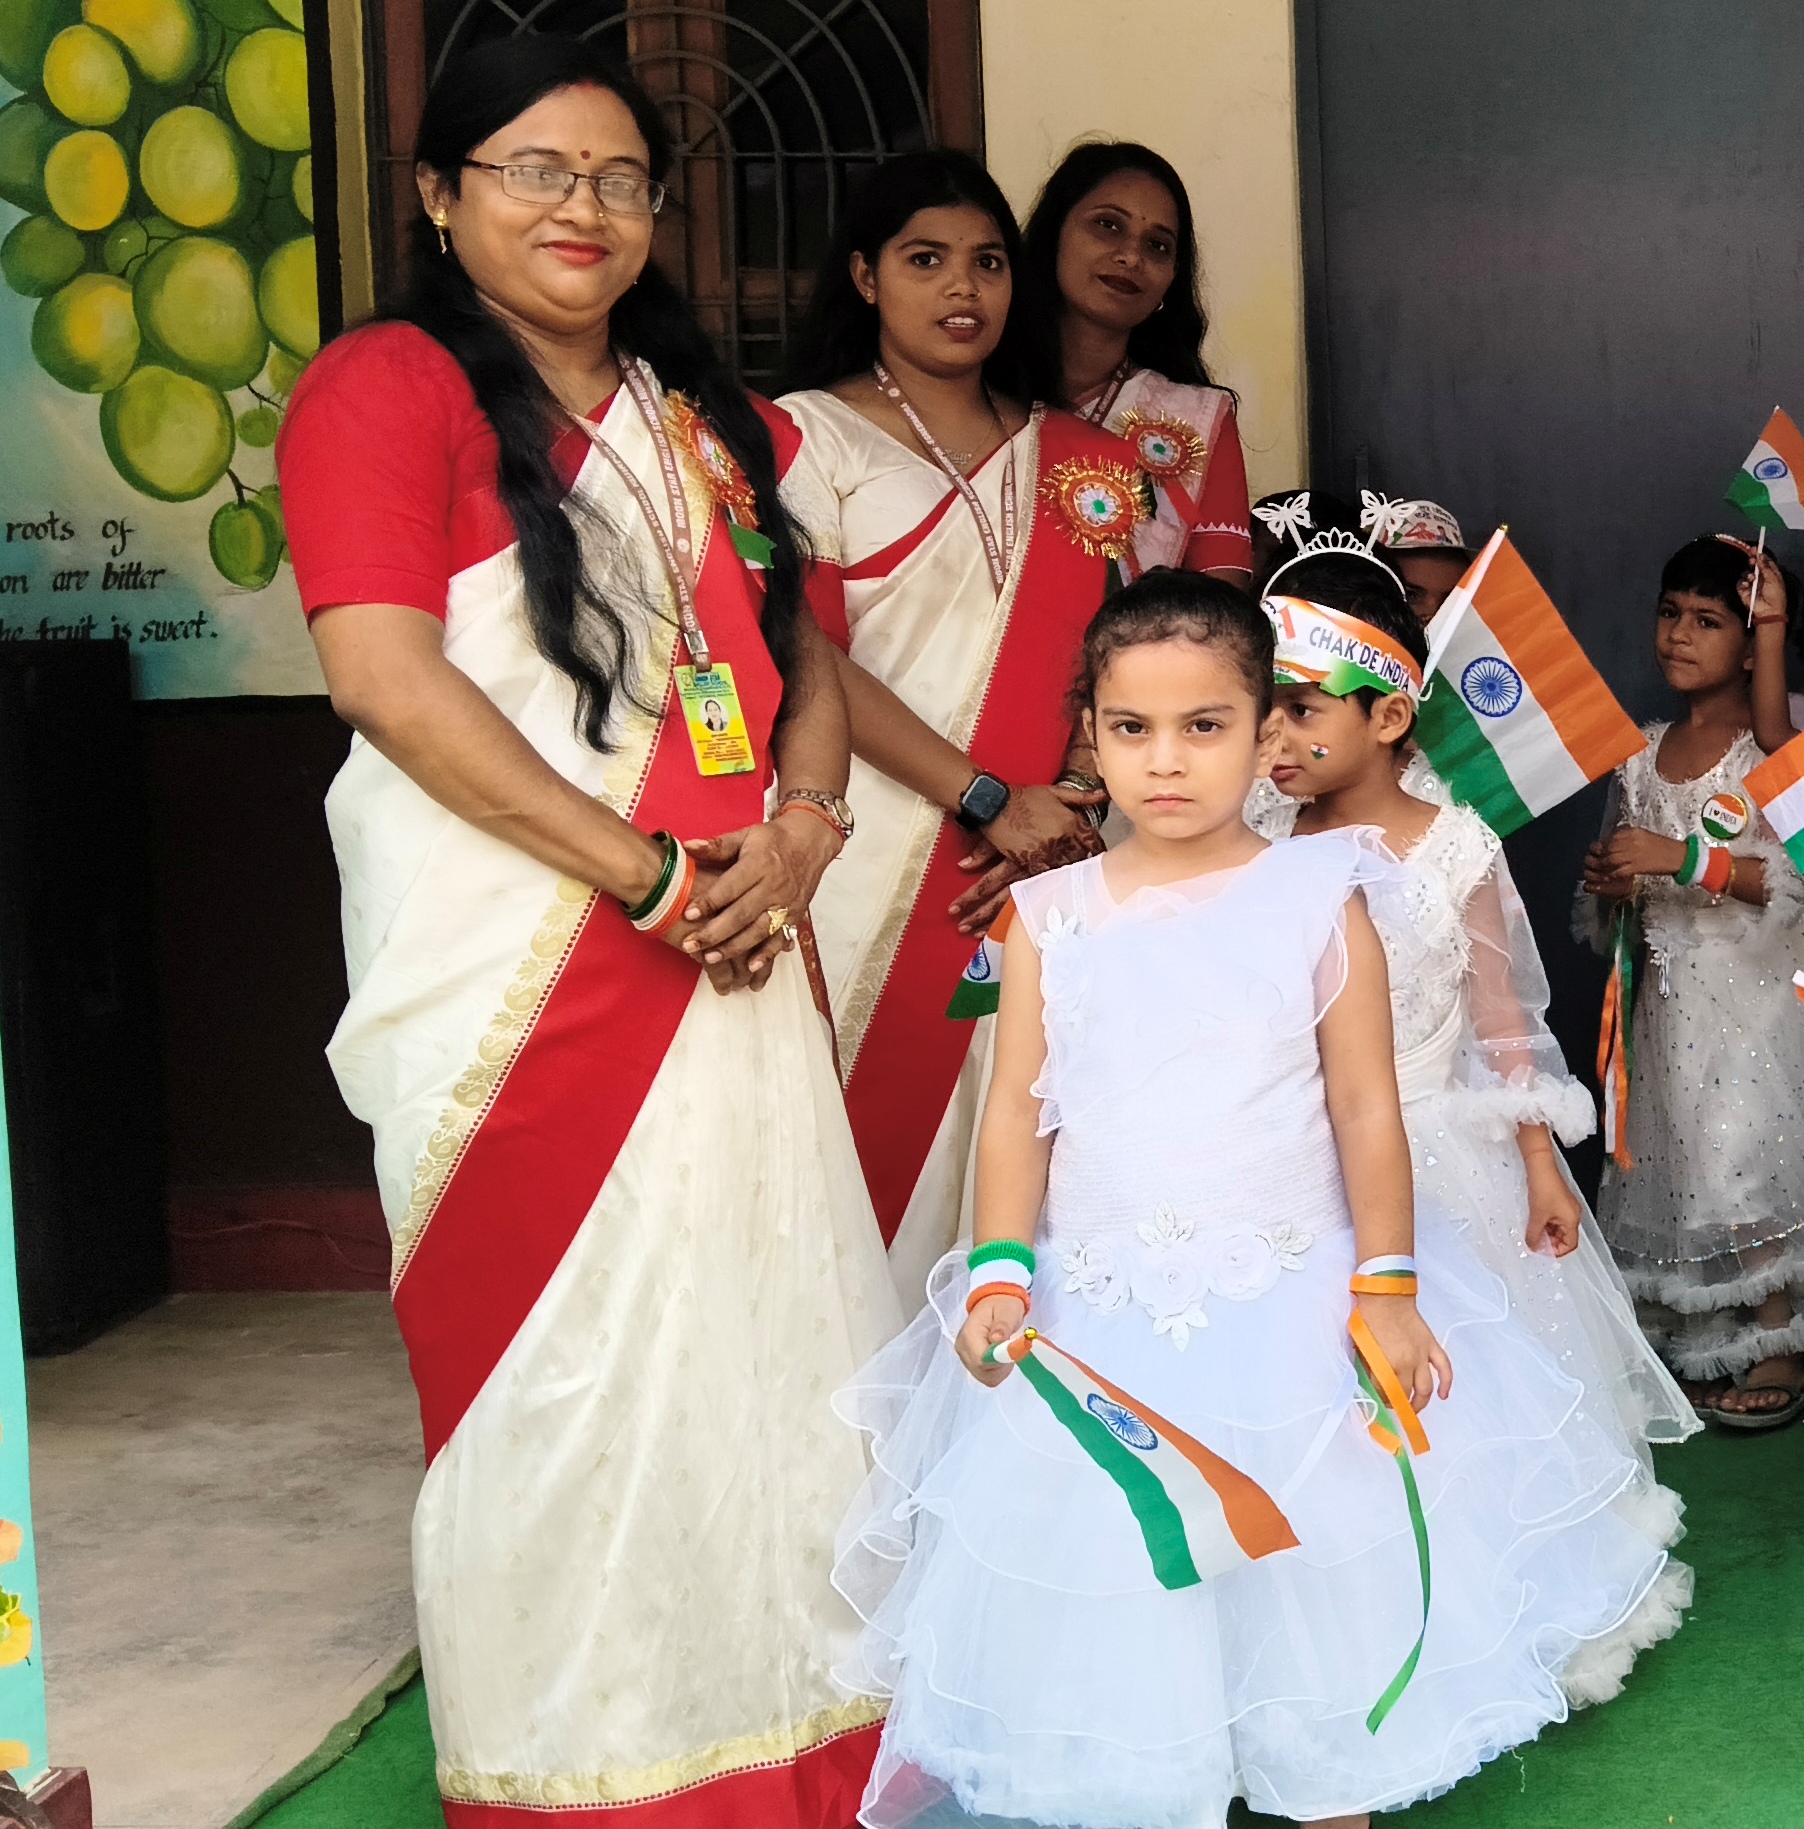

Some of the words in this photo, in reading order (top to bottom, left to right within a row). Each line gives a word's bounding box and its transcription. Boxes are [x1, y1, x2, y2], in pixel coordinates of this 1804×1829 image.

[6, 511, 75, 543] roots
[102, 516, 137, 557] of
[52, 570, 90, 592] are
[101, 561, 166, 591] bitter
[36, 614, 98, 640] fruit
[111, 614, 132, 640] is
[1309, 626, 1358, 661] CHAK
[1359, 644, 1380, 671] DE
[1379, 654, 1411, 692] INDIA
